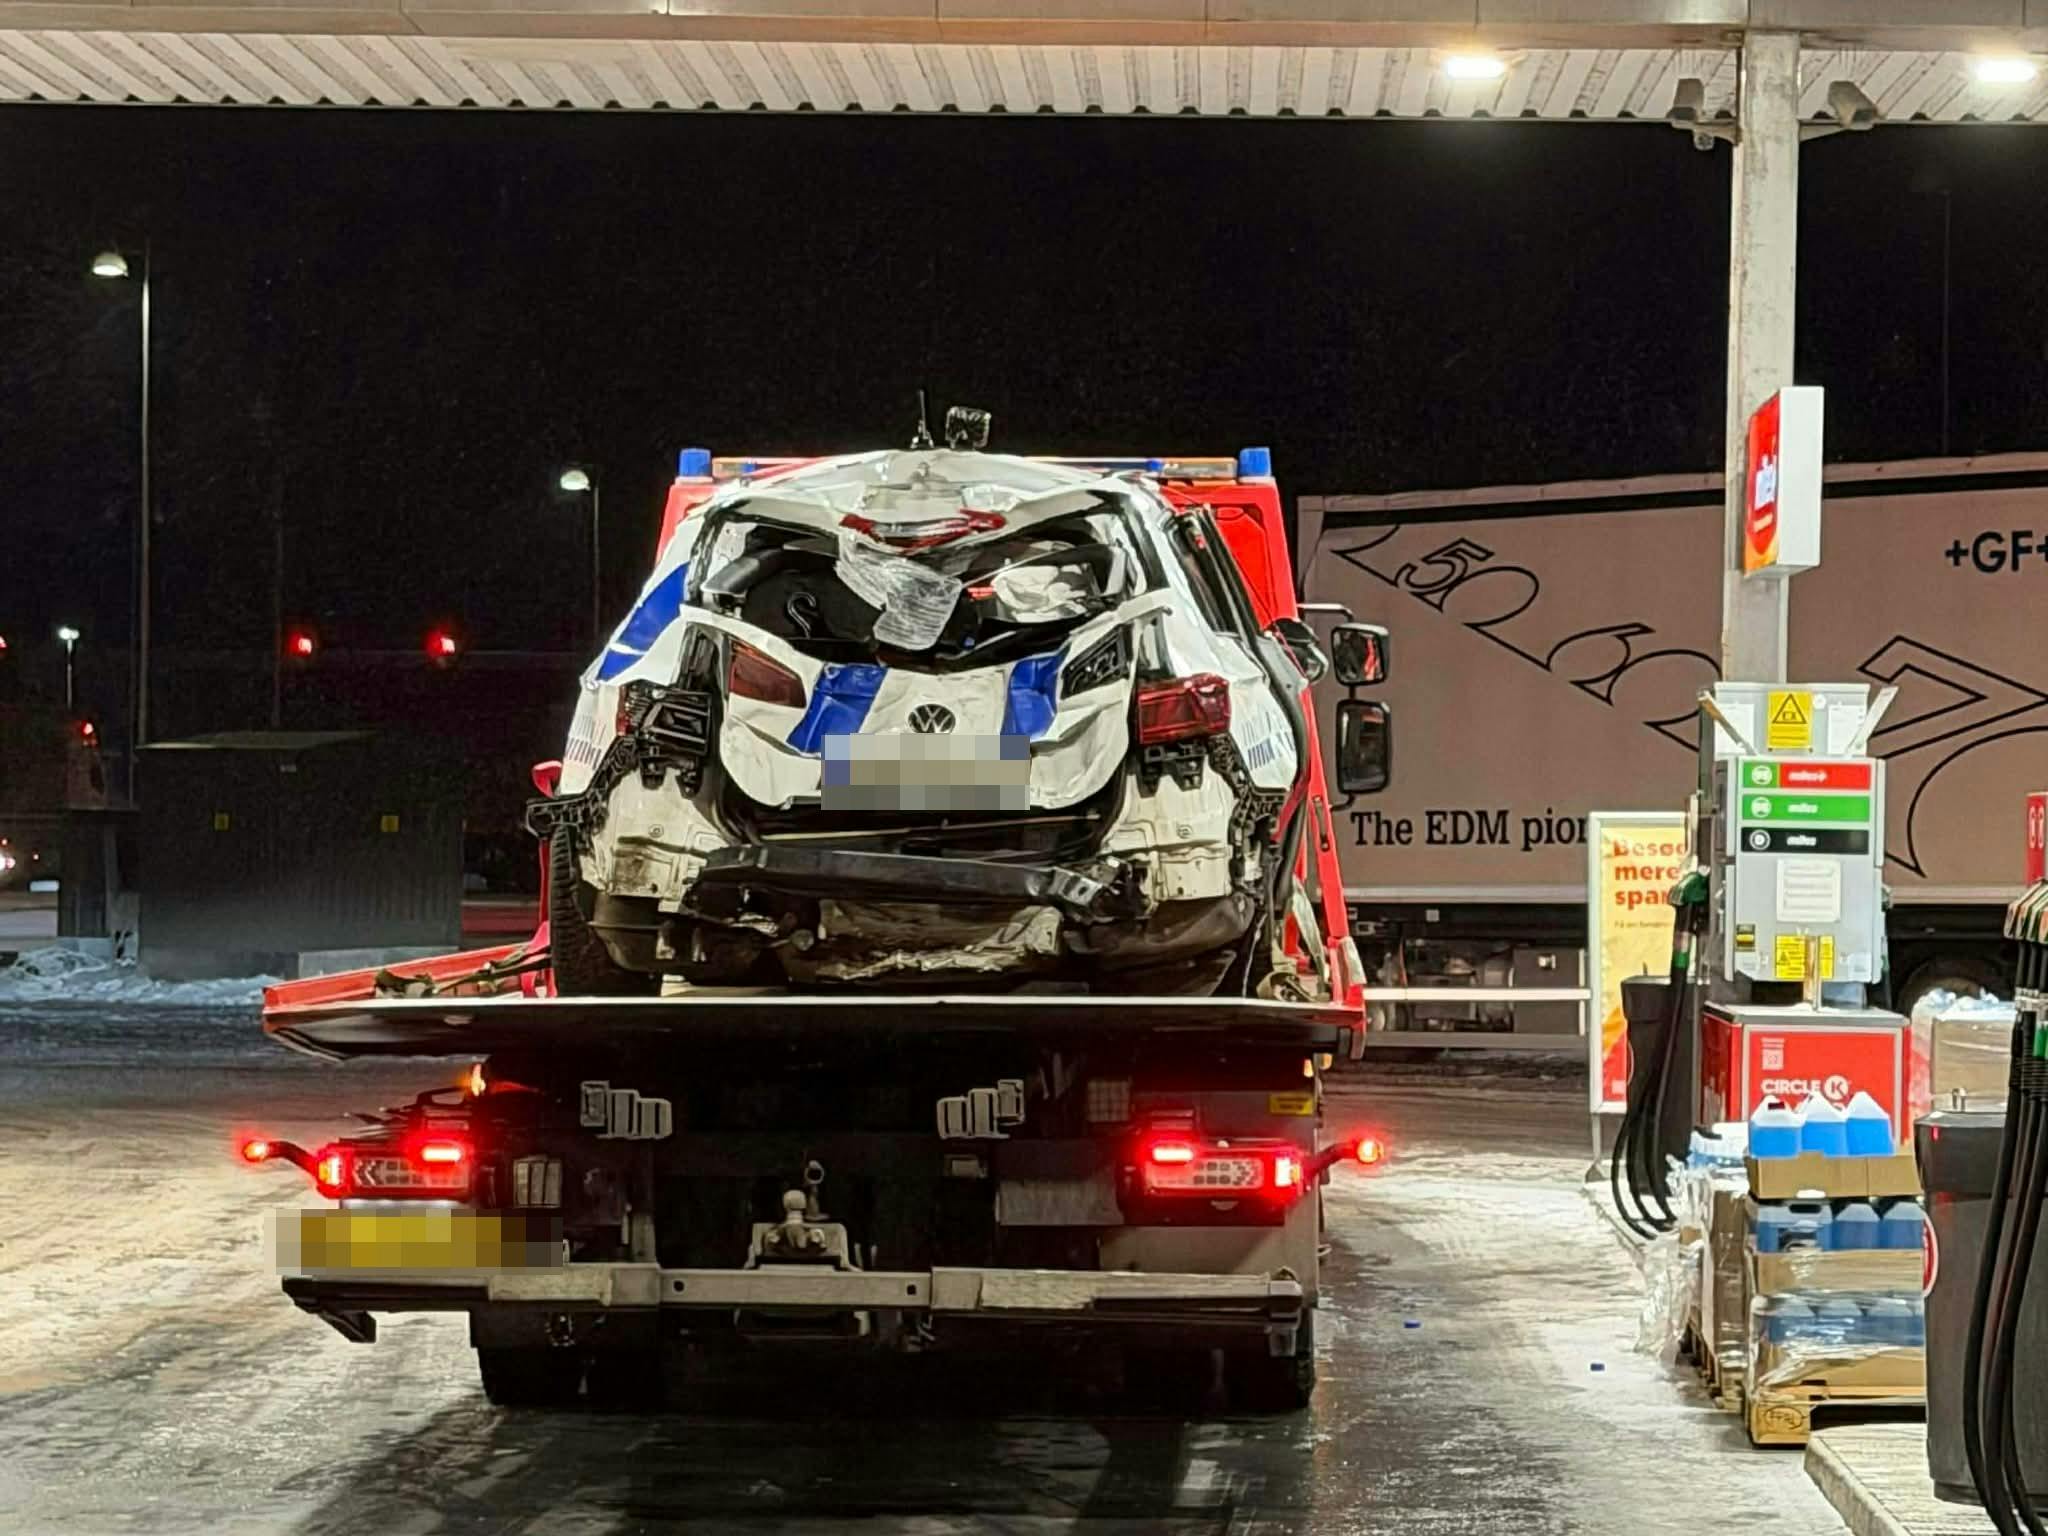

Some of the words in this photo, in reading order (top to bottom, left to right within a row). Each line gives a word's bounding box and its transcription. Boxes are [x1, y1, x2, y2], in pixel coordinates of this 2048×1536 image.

[1350, 810, 1413, 846] The
[1425, 809, 1510, 845] EDM
[1761, 1078, 1821, 1095] CIRCLE
